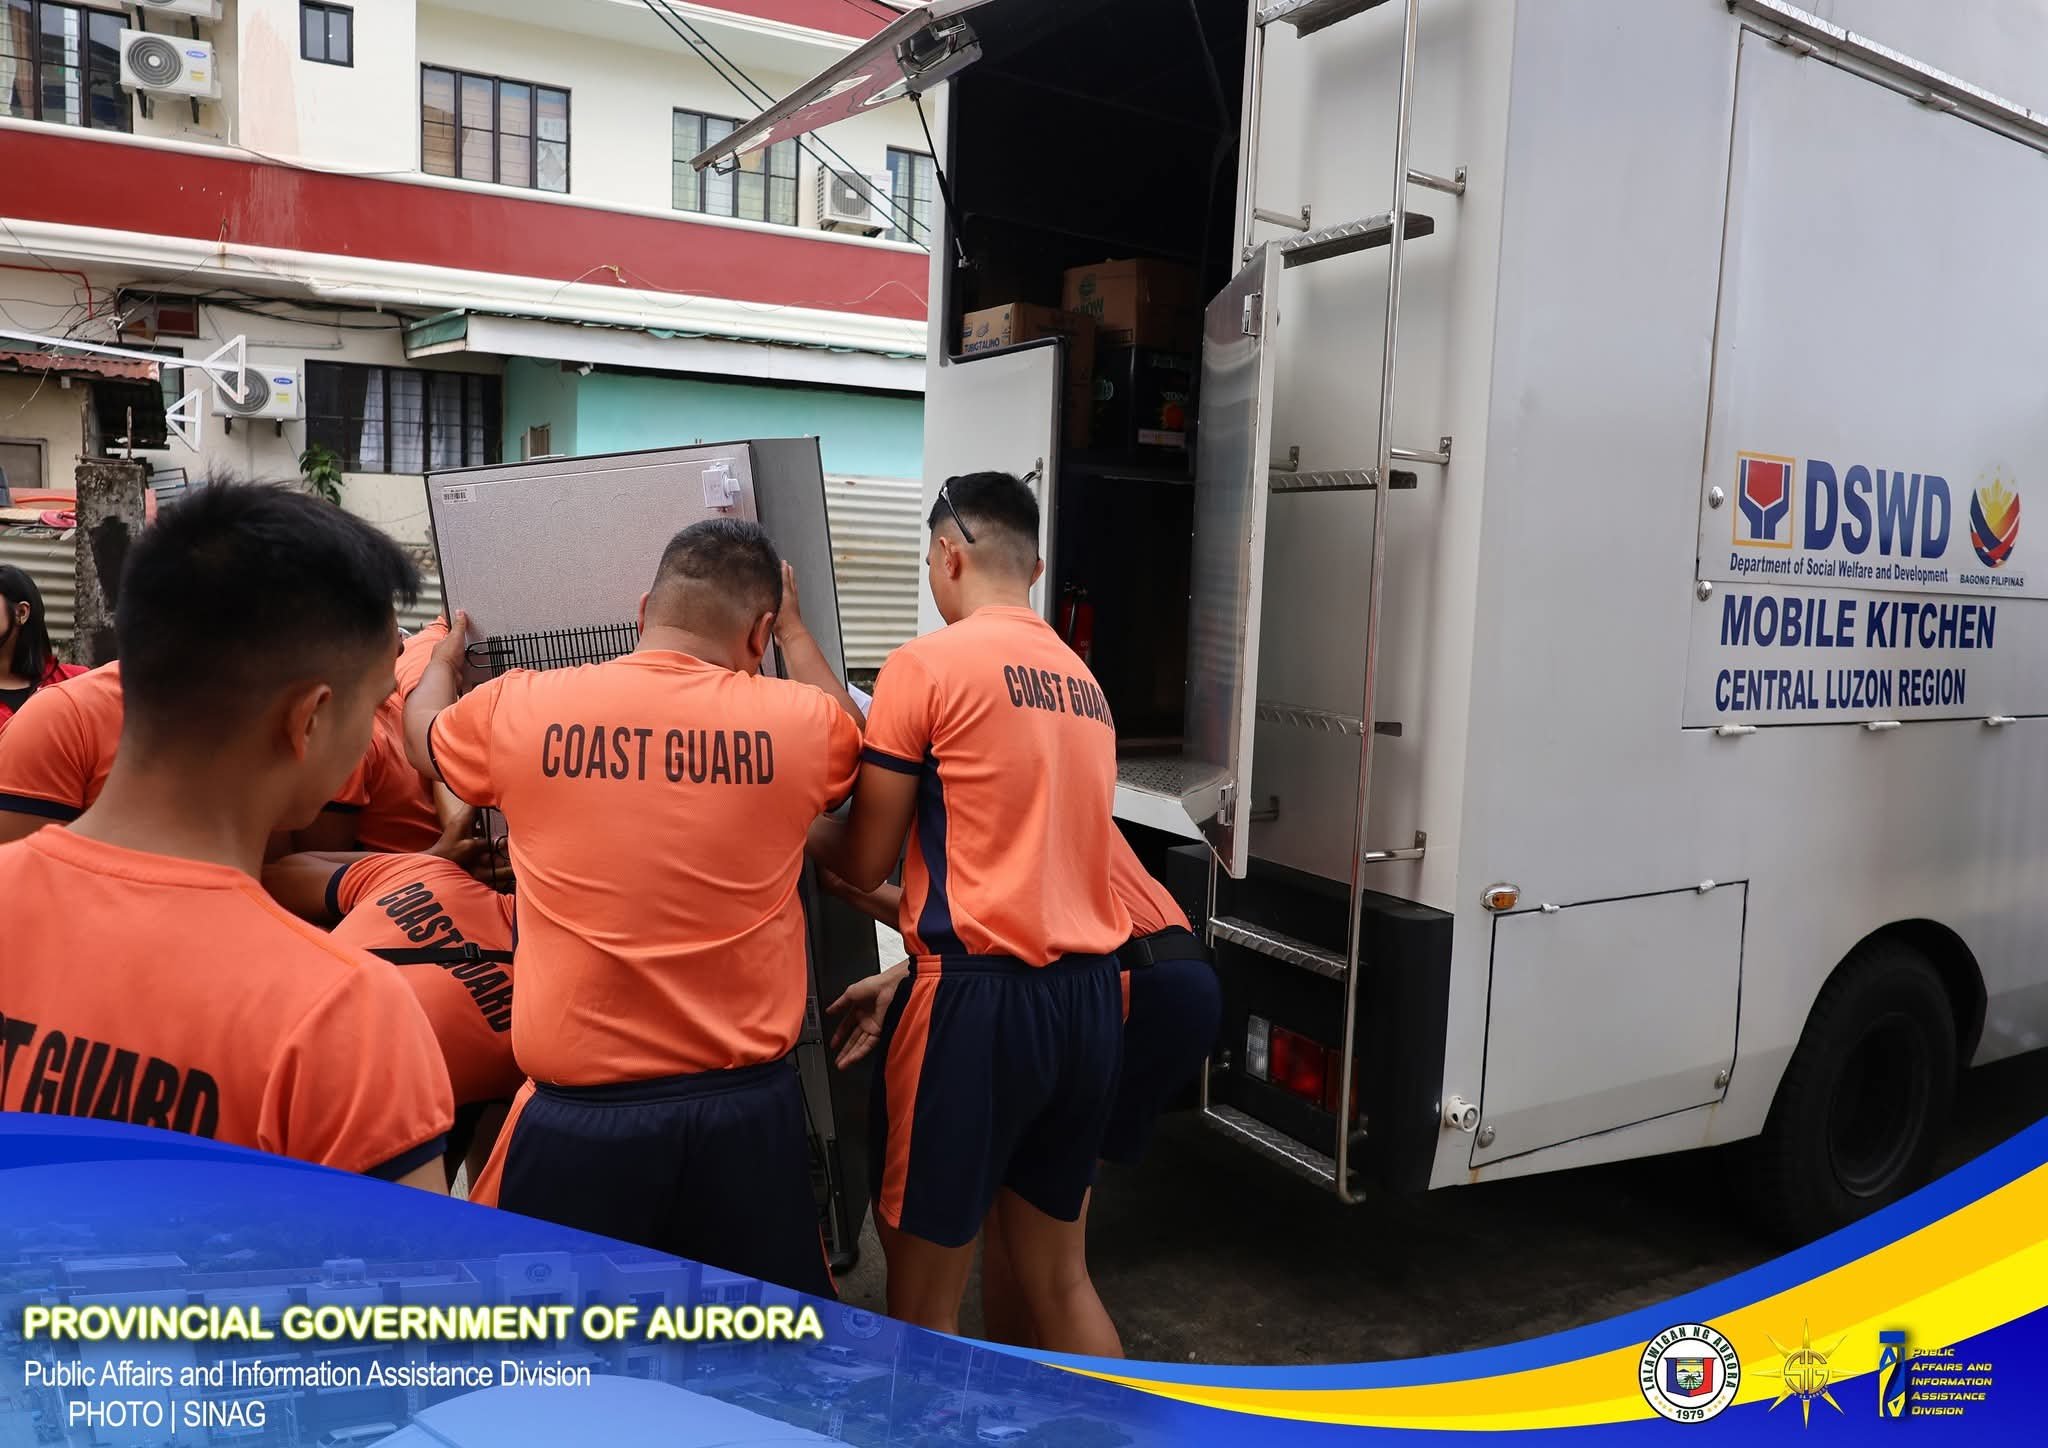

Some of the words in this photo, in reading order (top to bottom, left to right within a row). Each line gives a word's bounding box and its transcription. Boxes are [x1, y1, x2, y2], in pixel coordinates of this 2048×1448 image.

[1804, 459, 1951, 559] DSWD
[1730, 552, 1791, 576] Department
[1793, 557, 1804, 575] of
[1806, 558, 1836, 577] Social
[1839, 560, 1873, 579] Welfare
[1875, 563, 1892, 580] and
[1894, 564, 1948, 585] Development
[1960, 574, 1990, 585] BAGONG
[1991, 576, 2024, 587] PILIPINAS
[1721, 594, 1857, 647] MOBILE
[1866, 601, 1996, 649] KITCHEN
[1004, 665, 1065, 712] COAST
[1715, 669, 1819, 711] CENTRAL
[1825, 669, 1892, 708] LUZON
[1899, 668, 1966, 706] REGION
[542, 723, 653, 780] COAST
[665, 729, 774, 784] GUARD
